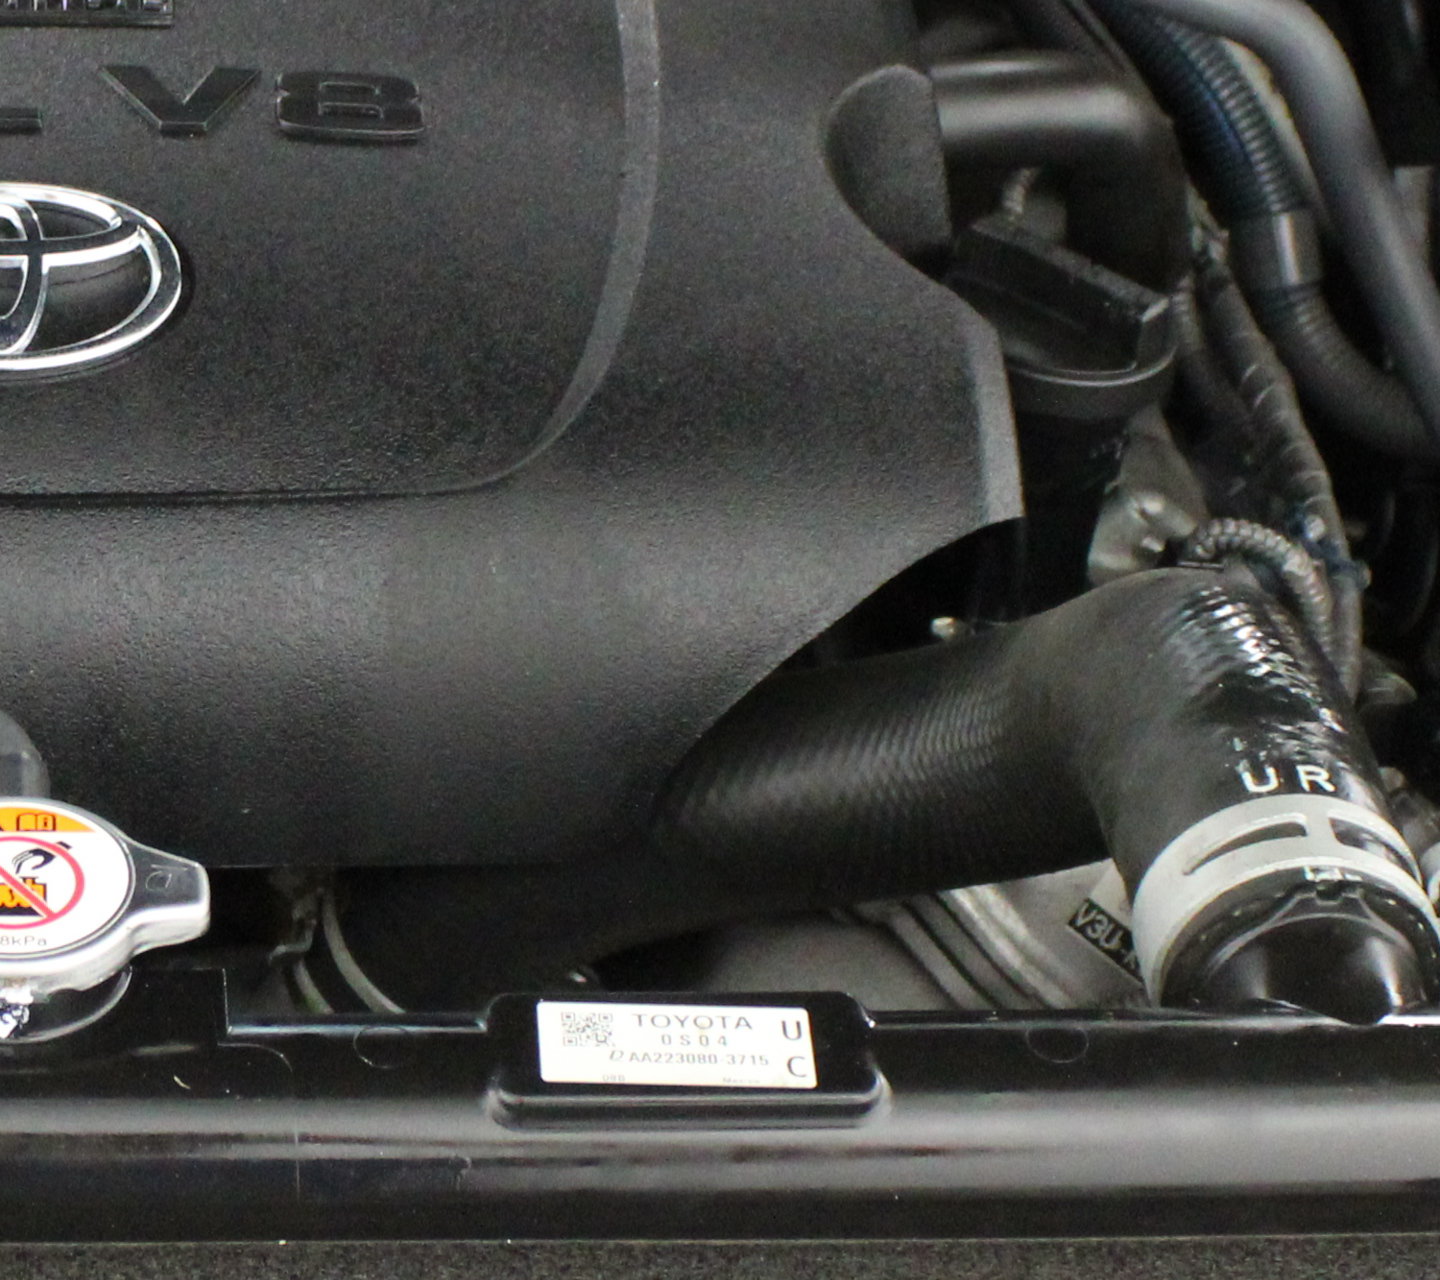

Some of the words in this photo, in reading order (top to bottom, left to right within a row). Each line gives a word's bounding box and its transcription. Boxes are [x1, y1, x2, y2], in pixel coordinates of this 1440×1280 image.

[97, 64, 427, 140] V8
[632, 1013, 753, 1031] TOYOTA
[781, 1020, 803, 1041] U
[786, 1056, 808, 1078] C
